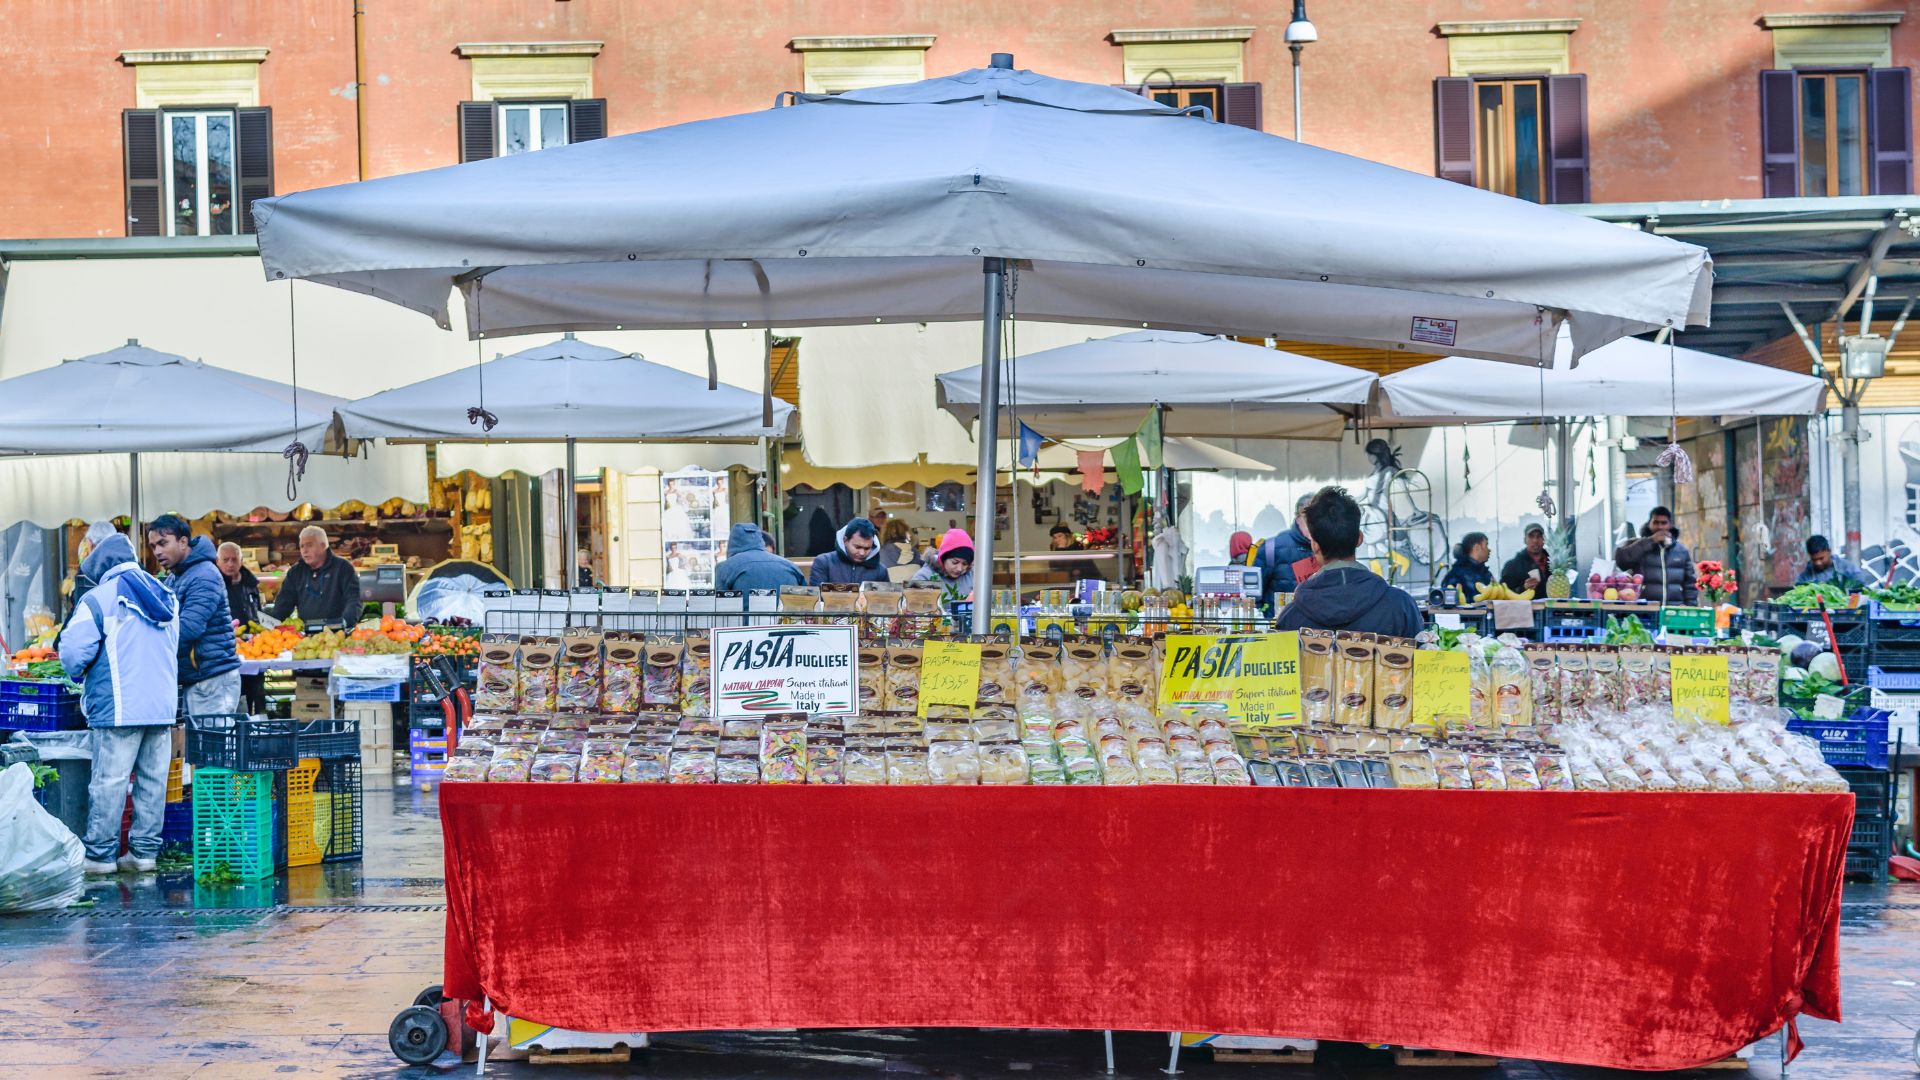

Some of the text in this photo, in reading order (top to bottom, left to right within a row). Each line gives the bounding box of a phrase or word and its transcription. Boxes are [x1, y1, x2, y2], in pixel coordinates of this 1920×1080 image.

[719, 630, 848, 672] PASTA PUGLIESE
[923, 656, 951, 668] PASTA
[1169, 636, 1296, 679] PASTA PUGLIESE
[722, 680, 753, 691] NATURAL
[786, 677, 816, 689] Sapori
[818, 678, 848, 688] italiani
[790, 690, 826, 700] Made in
[1235, 688, 1266, 700] Sapori
[1267, 687, 1297, 697] italiani
[796, 701, 821, 713] Italy
[1240, 702, 1275, 712] Made in
[1246, 712, 1270, 724] Italy
